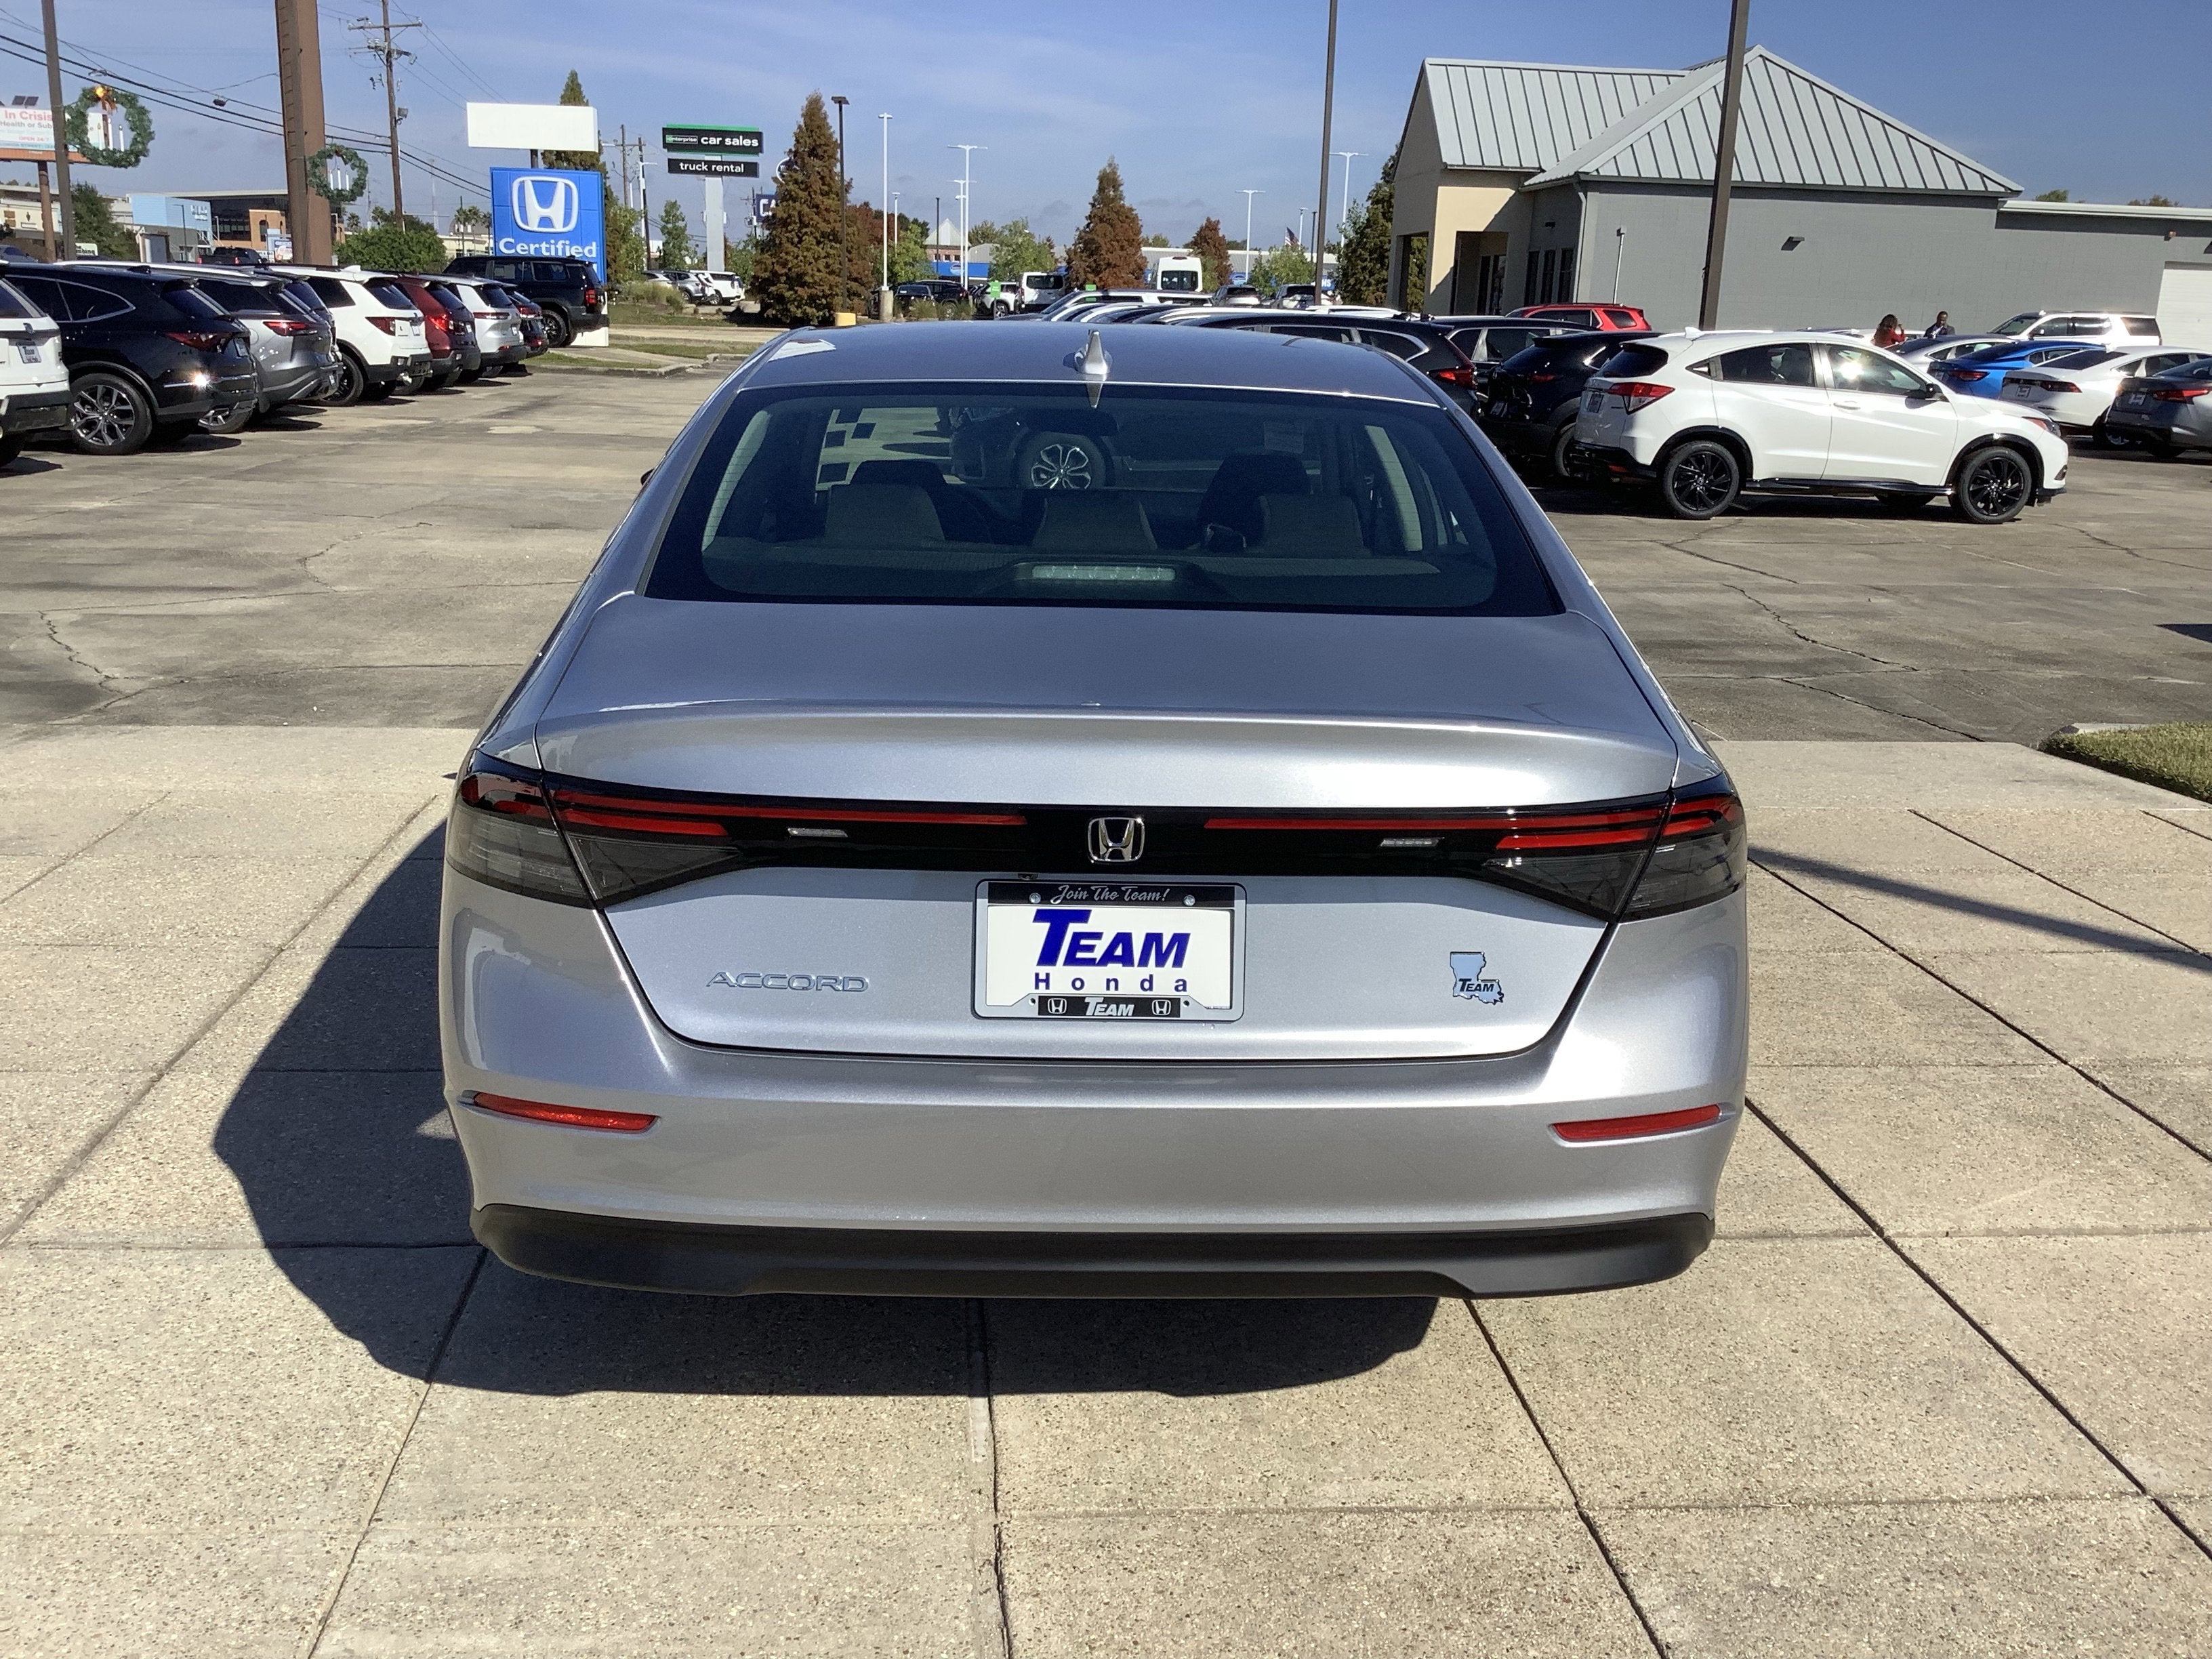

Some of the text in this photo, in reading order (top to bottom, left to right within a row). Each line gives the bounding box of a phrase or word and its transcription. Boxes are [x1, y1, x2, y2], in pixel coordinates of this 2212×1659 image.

[5, 110, 52, 121] In Crisis
[701, 136, 722, 145] car
[724, 136, 759, 147] sales
[680, 161, 744, 173] truck rental
[499, 237, 597, 258] Certified
[1050, 884, 1170, 905] Join The Team!
[1032, 908, 1191, 968] TEAM
[705, 972, 869, 992] ACCORD
[1034, 972, 1187, 993] Honda
[1458, 978, 1494, 992] TEAM
[1084, 997, 1134, 1017] TEAM
